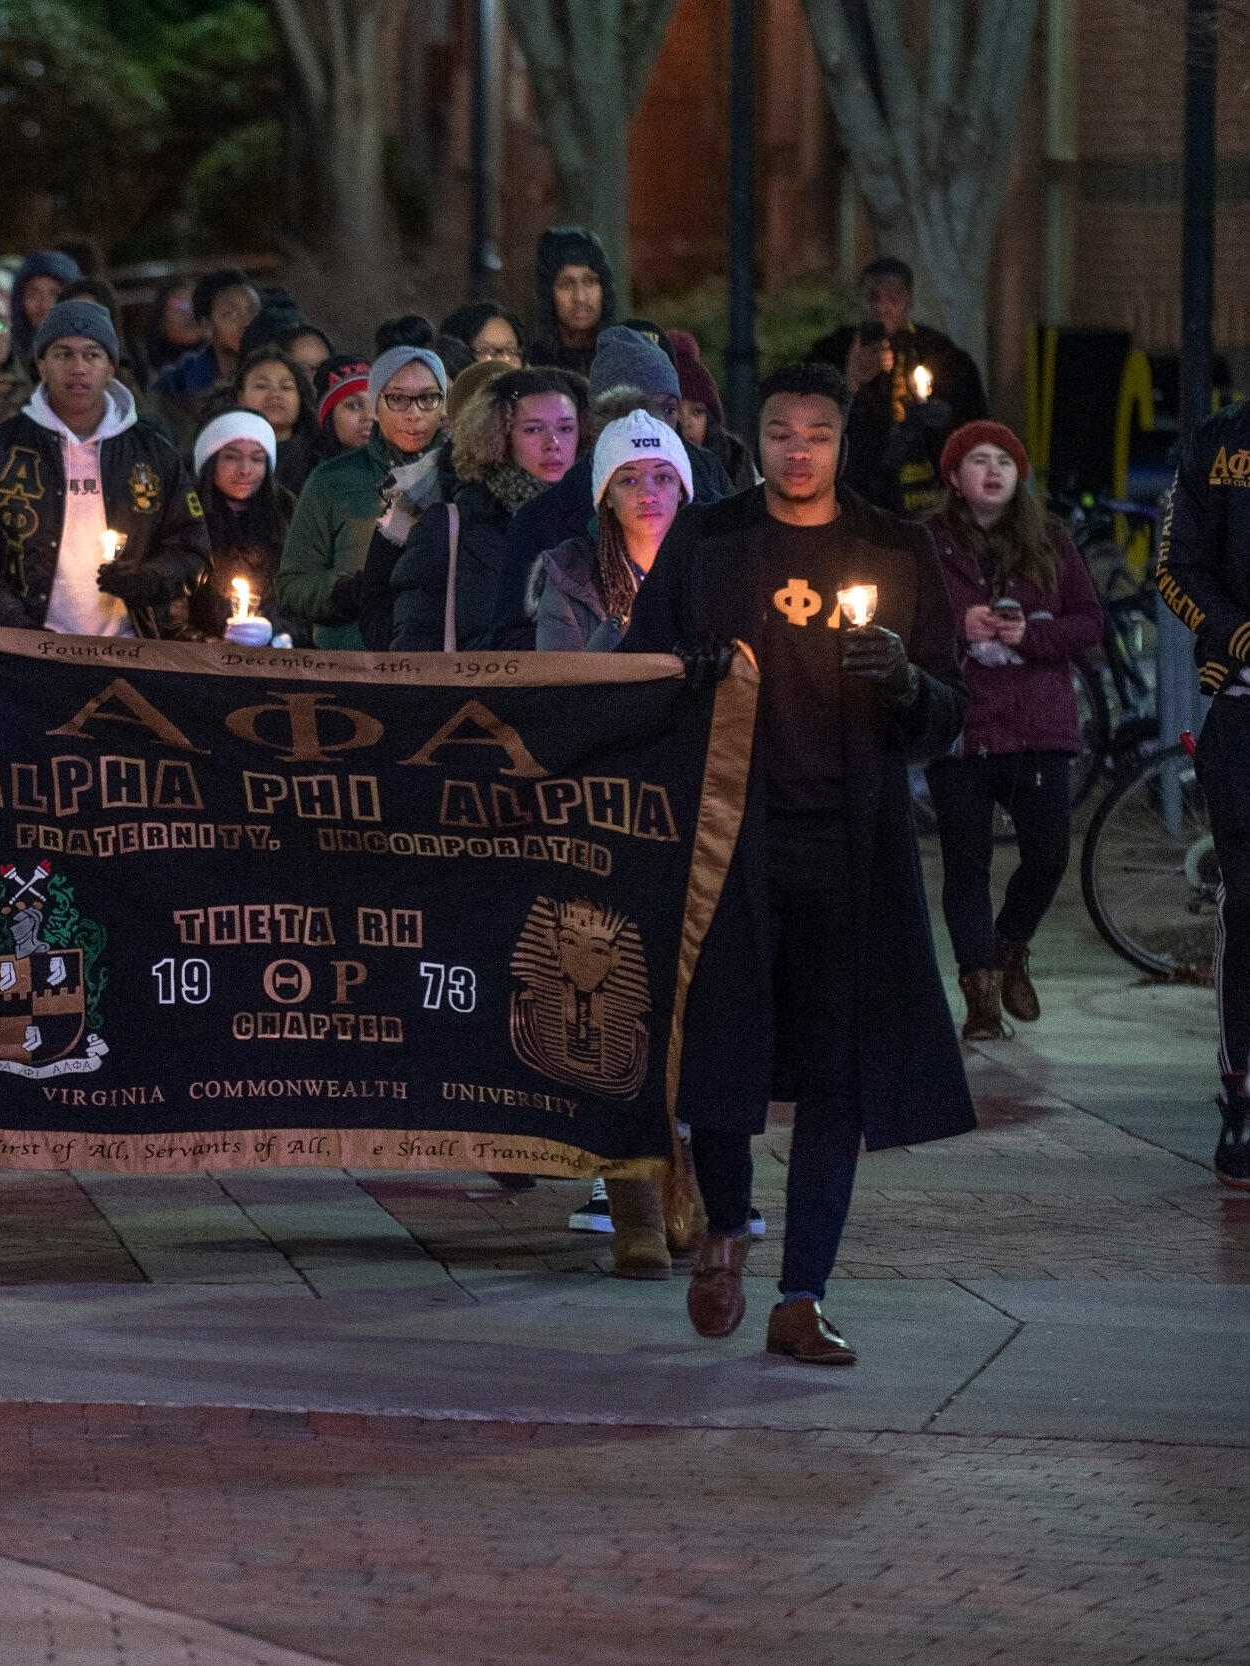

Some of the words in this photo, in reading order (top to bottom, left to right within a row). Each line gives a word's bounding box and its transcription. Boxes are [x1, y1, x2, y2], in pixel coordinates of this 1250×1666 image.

[631, 438, 661, 448] VCU
[1209, 446, 1250, 479] ΑΦ
[37, 641, 143, 659] Founded
[222, 653, 339, 671] December
[454, 660, 520, 676] 1906
[243, 770, 382, 822] PHI
[439, 776, 680, 842] ALPHA
[318, 827, 612, 878] INCORPORATED
[173, 903, 336, 947] THETA
[152, 958, 211, 1005] 19
[420, 961, 476, 1014] 73
[232, 1011, 404, 1043] CHAPTER
[42, 1086, 166, 1107] VIRGINIA
[188, 1079, 408, 1100] COMMONWEALTH
[442, 1081, 580, 1119] UNIVERSITY
[52, 1138, 77, 1162] of
[89, 1142, 130, 1161] All,
[144, 1139, 242, 1160] Servants
[253, 1136, 277, 1161] of
[287, 1136, 331, 1156] All,
[397, 1138, 459, 1157] Shall
[472, 1140, 585, 1171] Transcend
